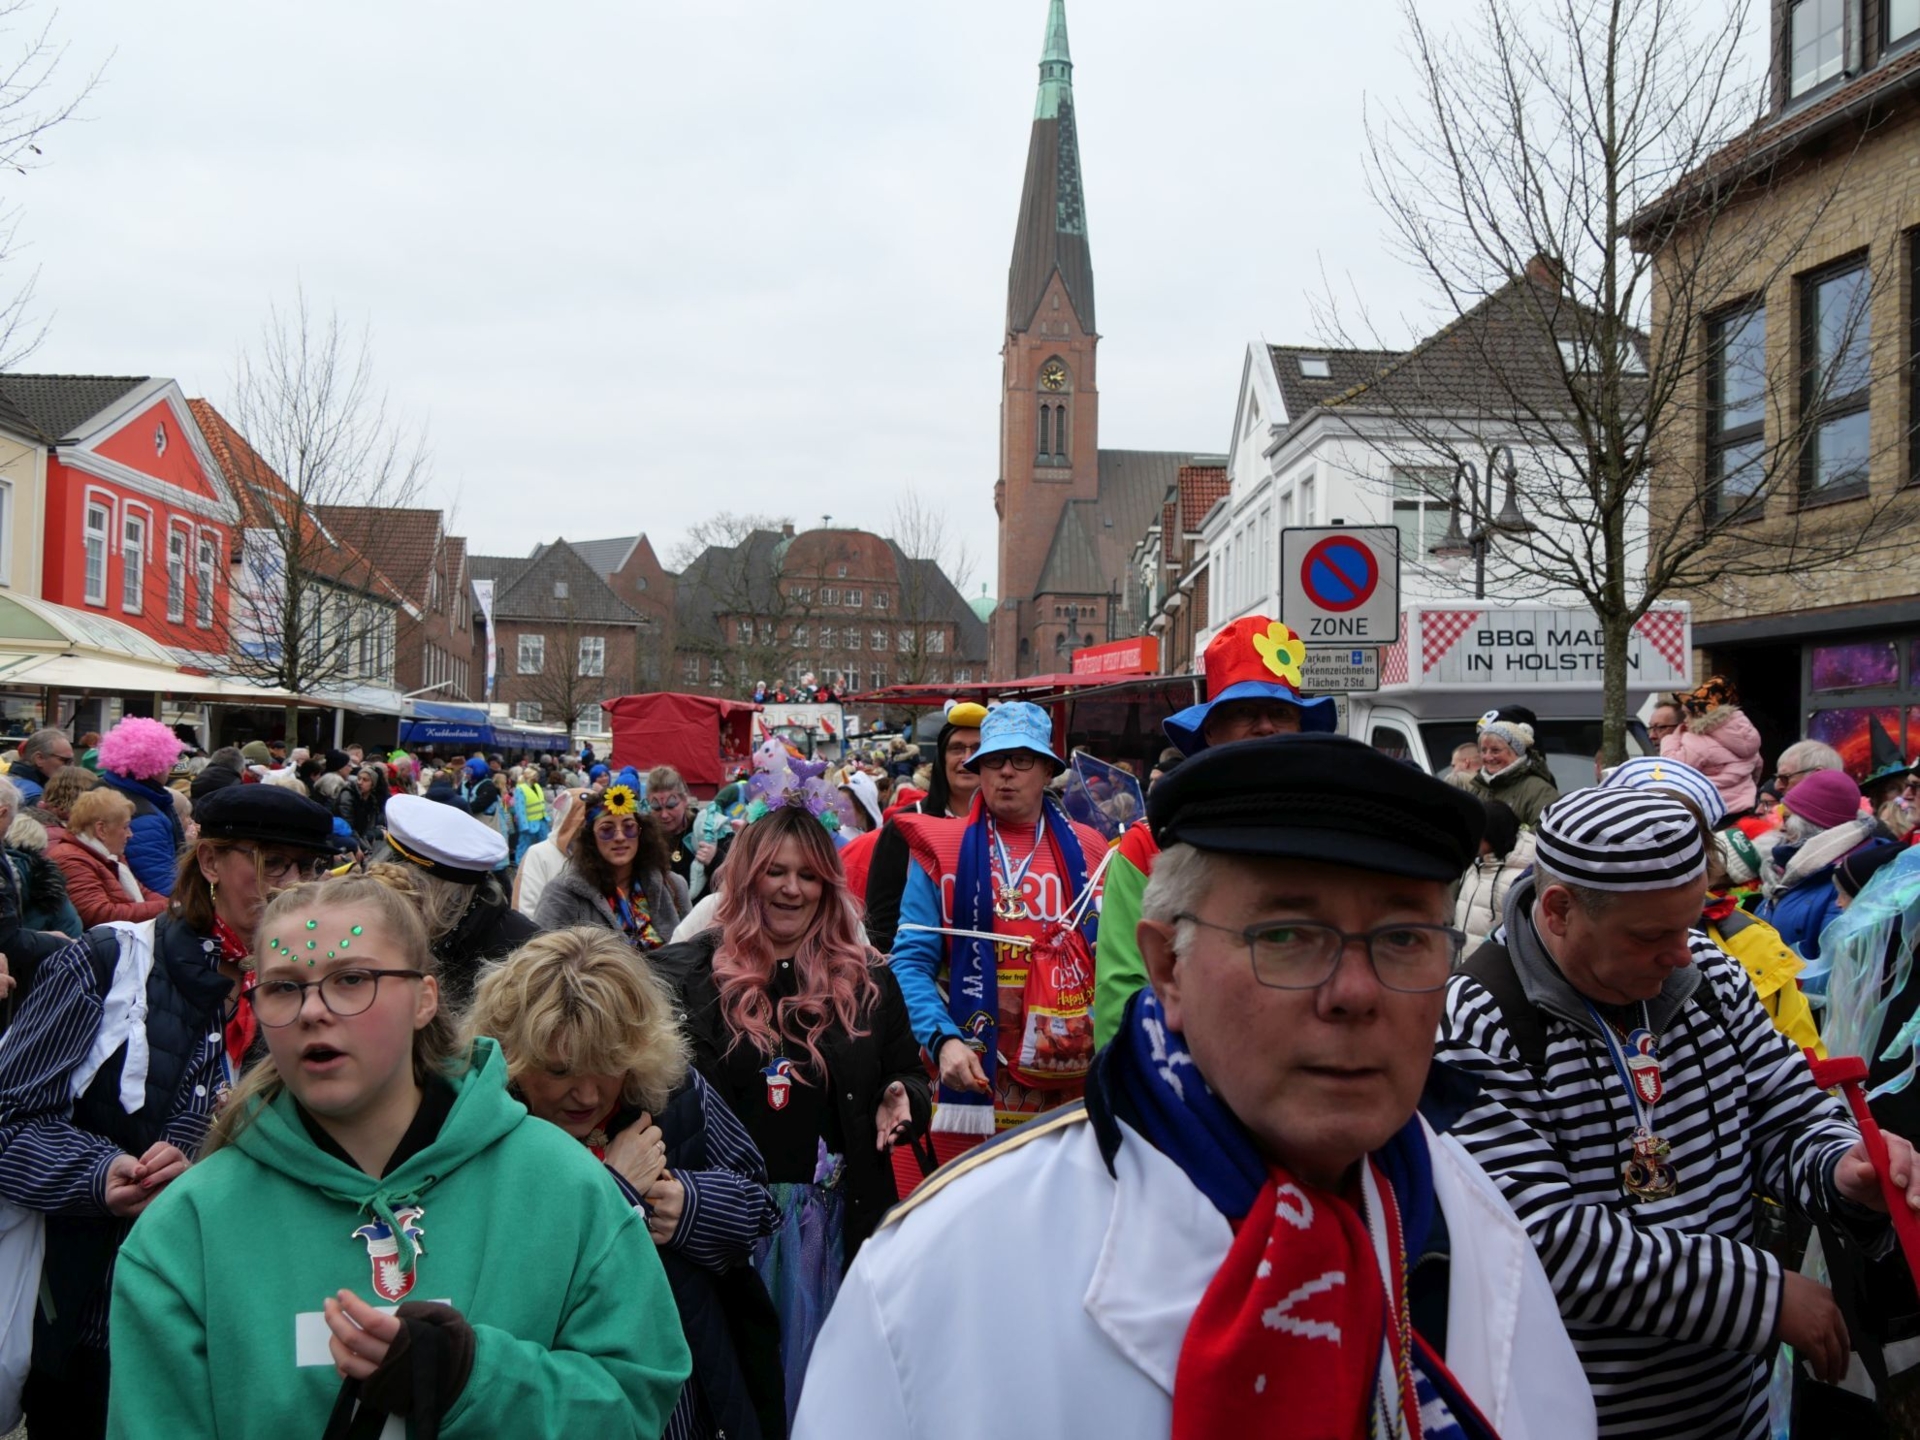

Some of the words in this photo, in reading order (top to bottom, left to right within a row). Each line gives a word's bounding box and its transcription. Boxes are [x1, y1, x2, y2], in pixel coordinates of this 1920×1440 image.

[1310, 617, 1369, 636] ZONE
[1477, 630, 1536, 647] BBQ
[1547, 630, 1607, 647] MAD
[1305, 653, 1331, 663] arken
[1335, 652, 1349, 663] mit
[1364, 652, 1373, 663] in
[1467, 653, 1493, 671] IN
[1506, 653, 1640, 671] HOLSTEN
[1307, 677, 1340, 688] Flächen
[1344, 677, 1349, 688] 2
[1350, 677, 1368, 688] Std.
